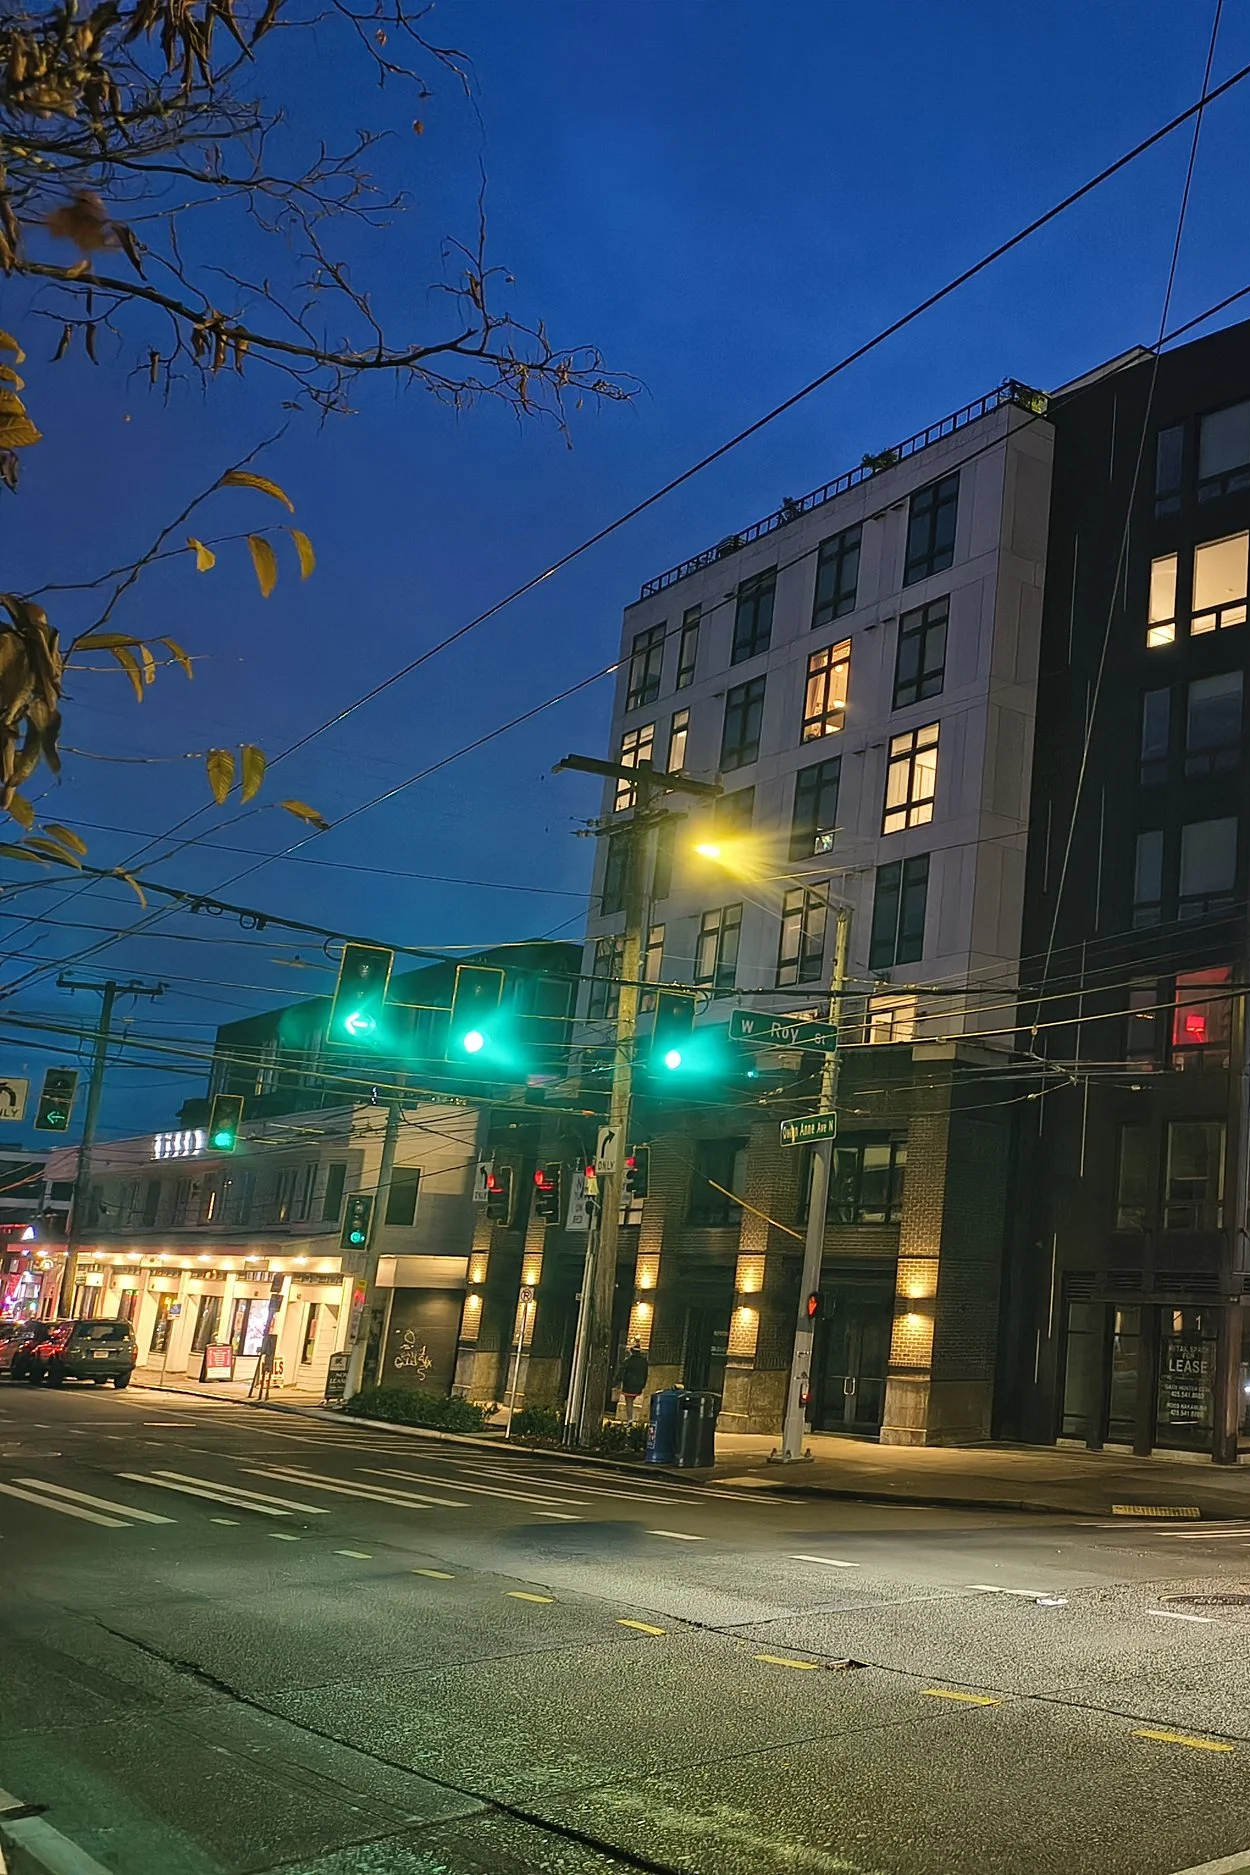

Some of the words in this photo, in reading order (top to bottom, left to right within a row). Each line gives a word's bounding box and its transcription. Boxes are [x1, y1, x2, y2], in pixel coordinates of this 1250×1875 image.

[741, 1019, 754, 1034] W
[770, 1022, 799, 1044] Roy
[814, 1033, 826, 1045] St
[800, 1122, 815, 1136] Anne
[816, 1121, 827, 1134] Ave
[828, 1119, 834, 1132] N
[597, 1159, 616, 1171] ONLY
[1168, 1359, 1208, 1374] LEASE
